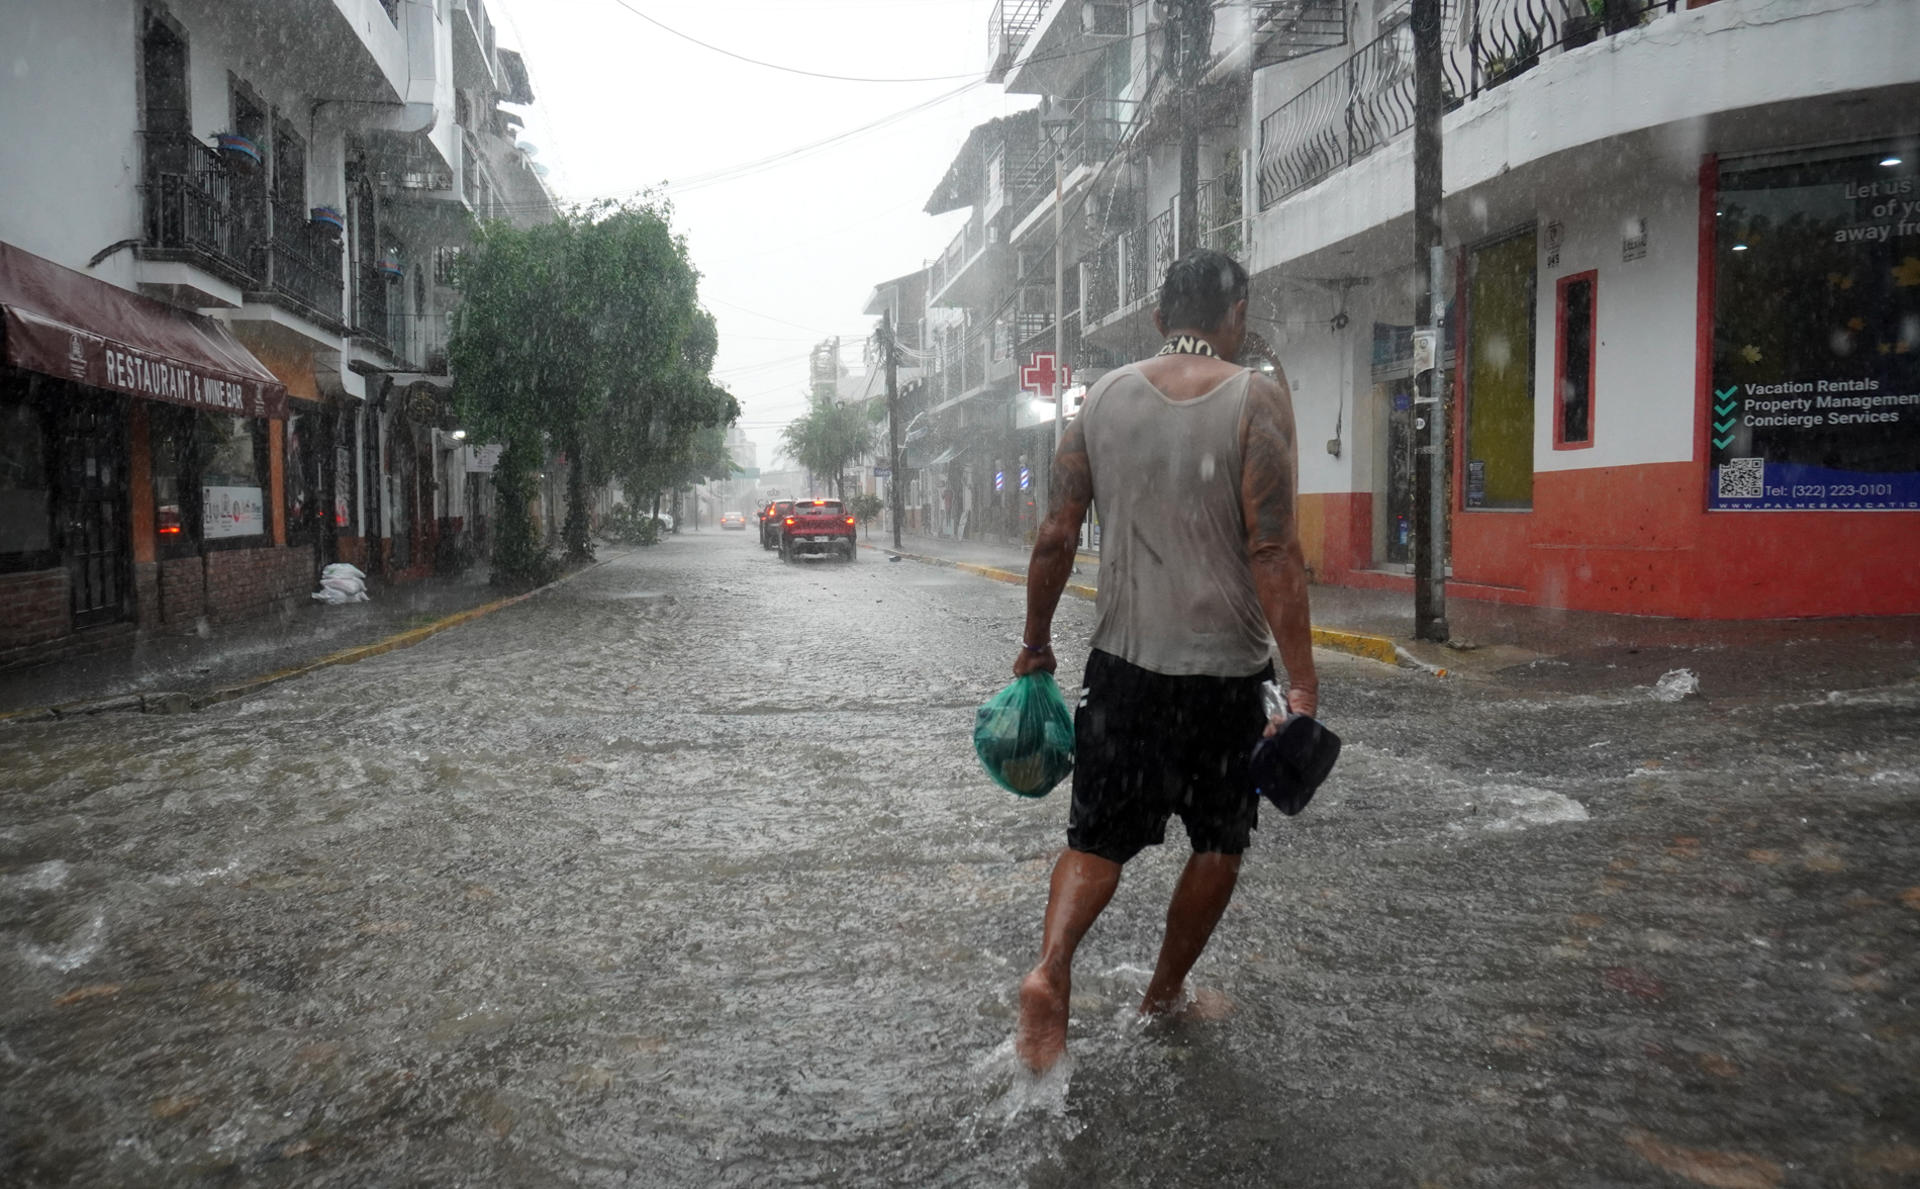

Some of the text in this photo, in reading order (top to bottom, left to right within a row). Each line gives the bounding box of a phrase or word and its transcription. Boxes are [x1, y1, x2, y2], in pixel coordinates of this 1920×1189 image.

[1845, 180, 1912, 199] Let us
[1873, 199, 1896, 217] of
[1834, 225, 1891, 242] away
[105, 350, 191, 400] RESTAURANT
[194, 375, 201, 402] &
[204, 377, 226, 406] WINE
[226, 382, 244, 409] BAR
[1745, 378, 1880, 395] Vacation Rentals
[1744, 394, 1920, 413] Property Managemen
[1744, 411, 1900, 428] Concierge Services
[1766, 484, 1892, 498] Tel: (322) 223-0101
